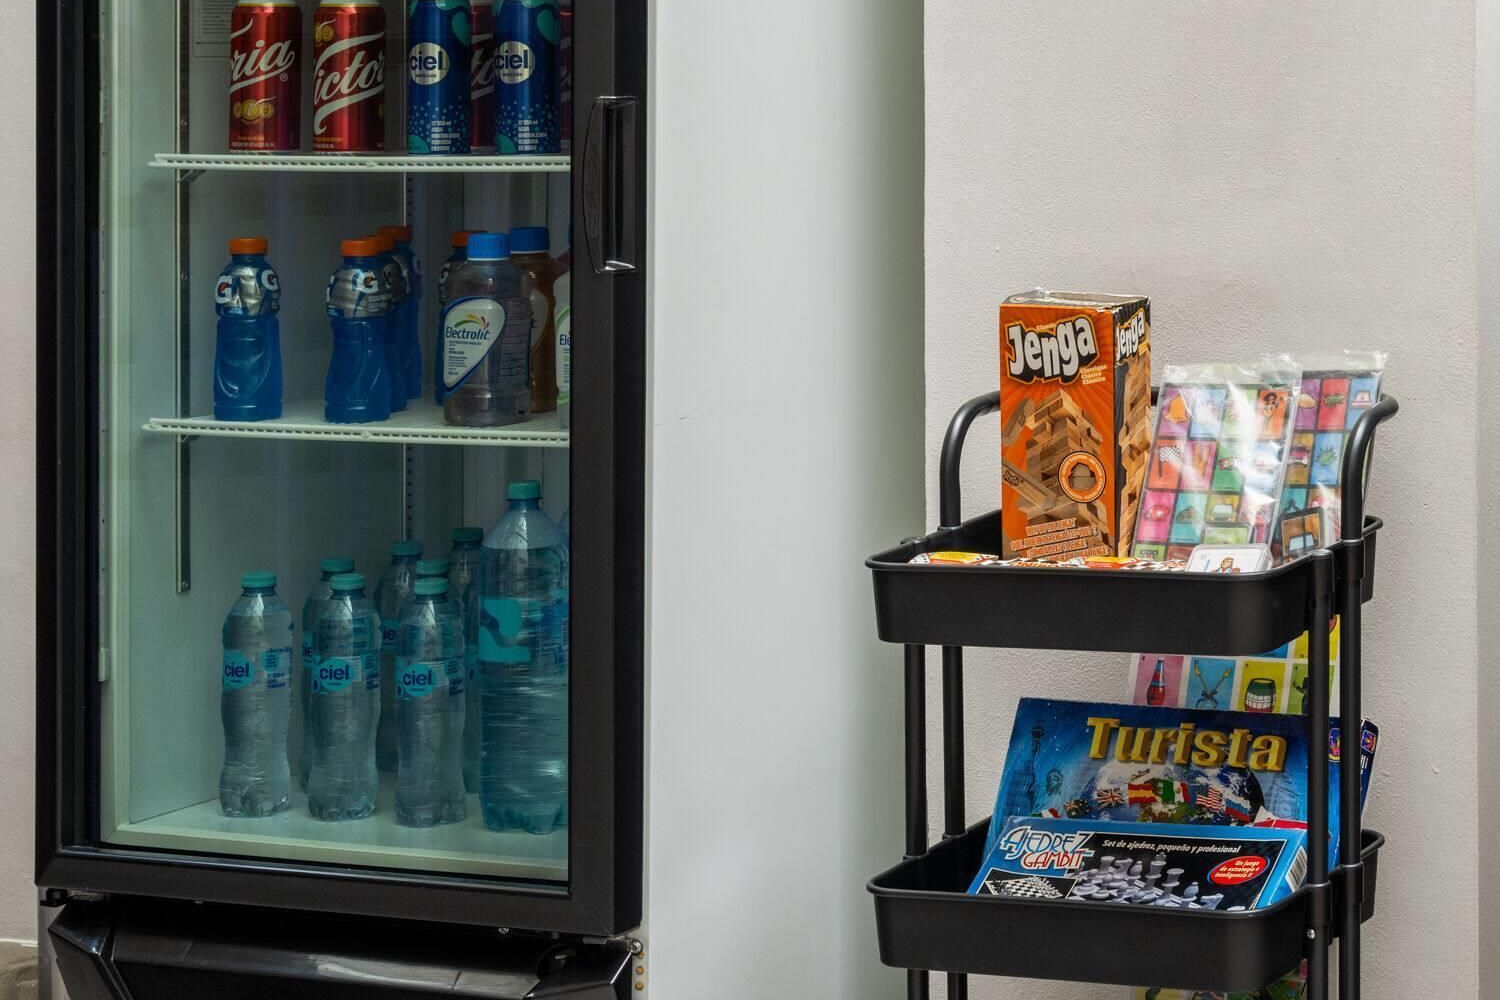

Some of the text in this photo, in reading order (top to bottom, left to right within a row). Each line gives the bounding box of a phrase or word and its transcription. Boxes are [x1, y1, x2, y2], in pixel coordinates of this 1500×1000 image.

[410, 51, 443, 71] ciel
[494, 49, 529, 70] ciel
[445, 326, 491, 340] Electrolit
[1115, 311, 1146, 362] Jenga
[1008, 316, 1097, 378] Jenga
[225, 662, 250, 678] ciel
[319, 664, 350, 681] ciel
[402, 669, 433, 686] ciel
[1087, 716, 1289, 773] Turista
[1000, 825, 1095, 862] AJEDREZ
[1102, 838, 1240, 854] Set de ajedrez, pequeño y profesional
[1022, 849, 1086, 869] GAMBIT
[1243, 860, 1260, 869] juego
[1214, 871, 1248, 880] inteligencia
[1228, 865, 1255, 875] estrategia
